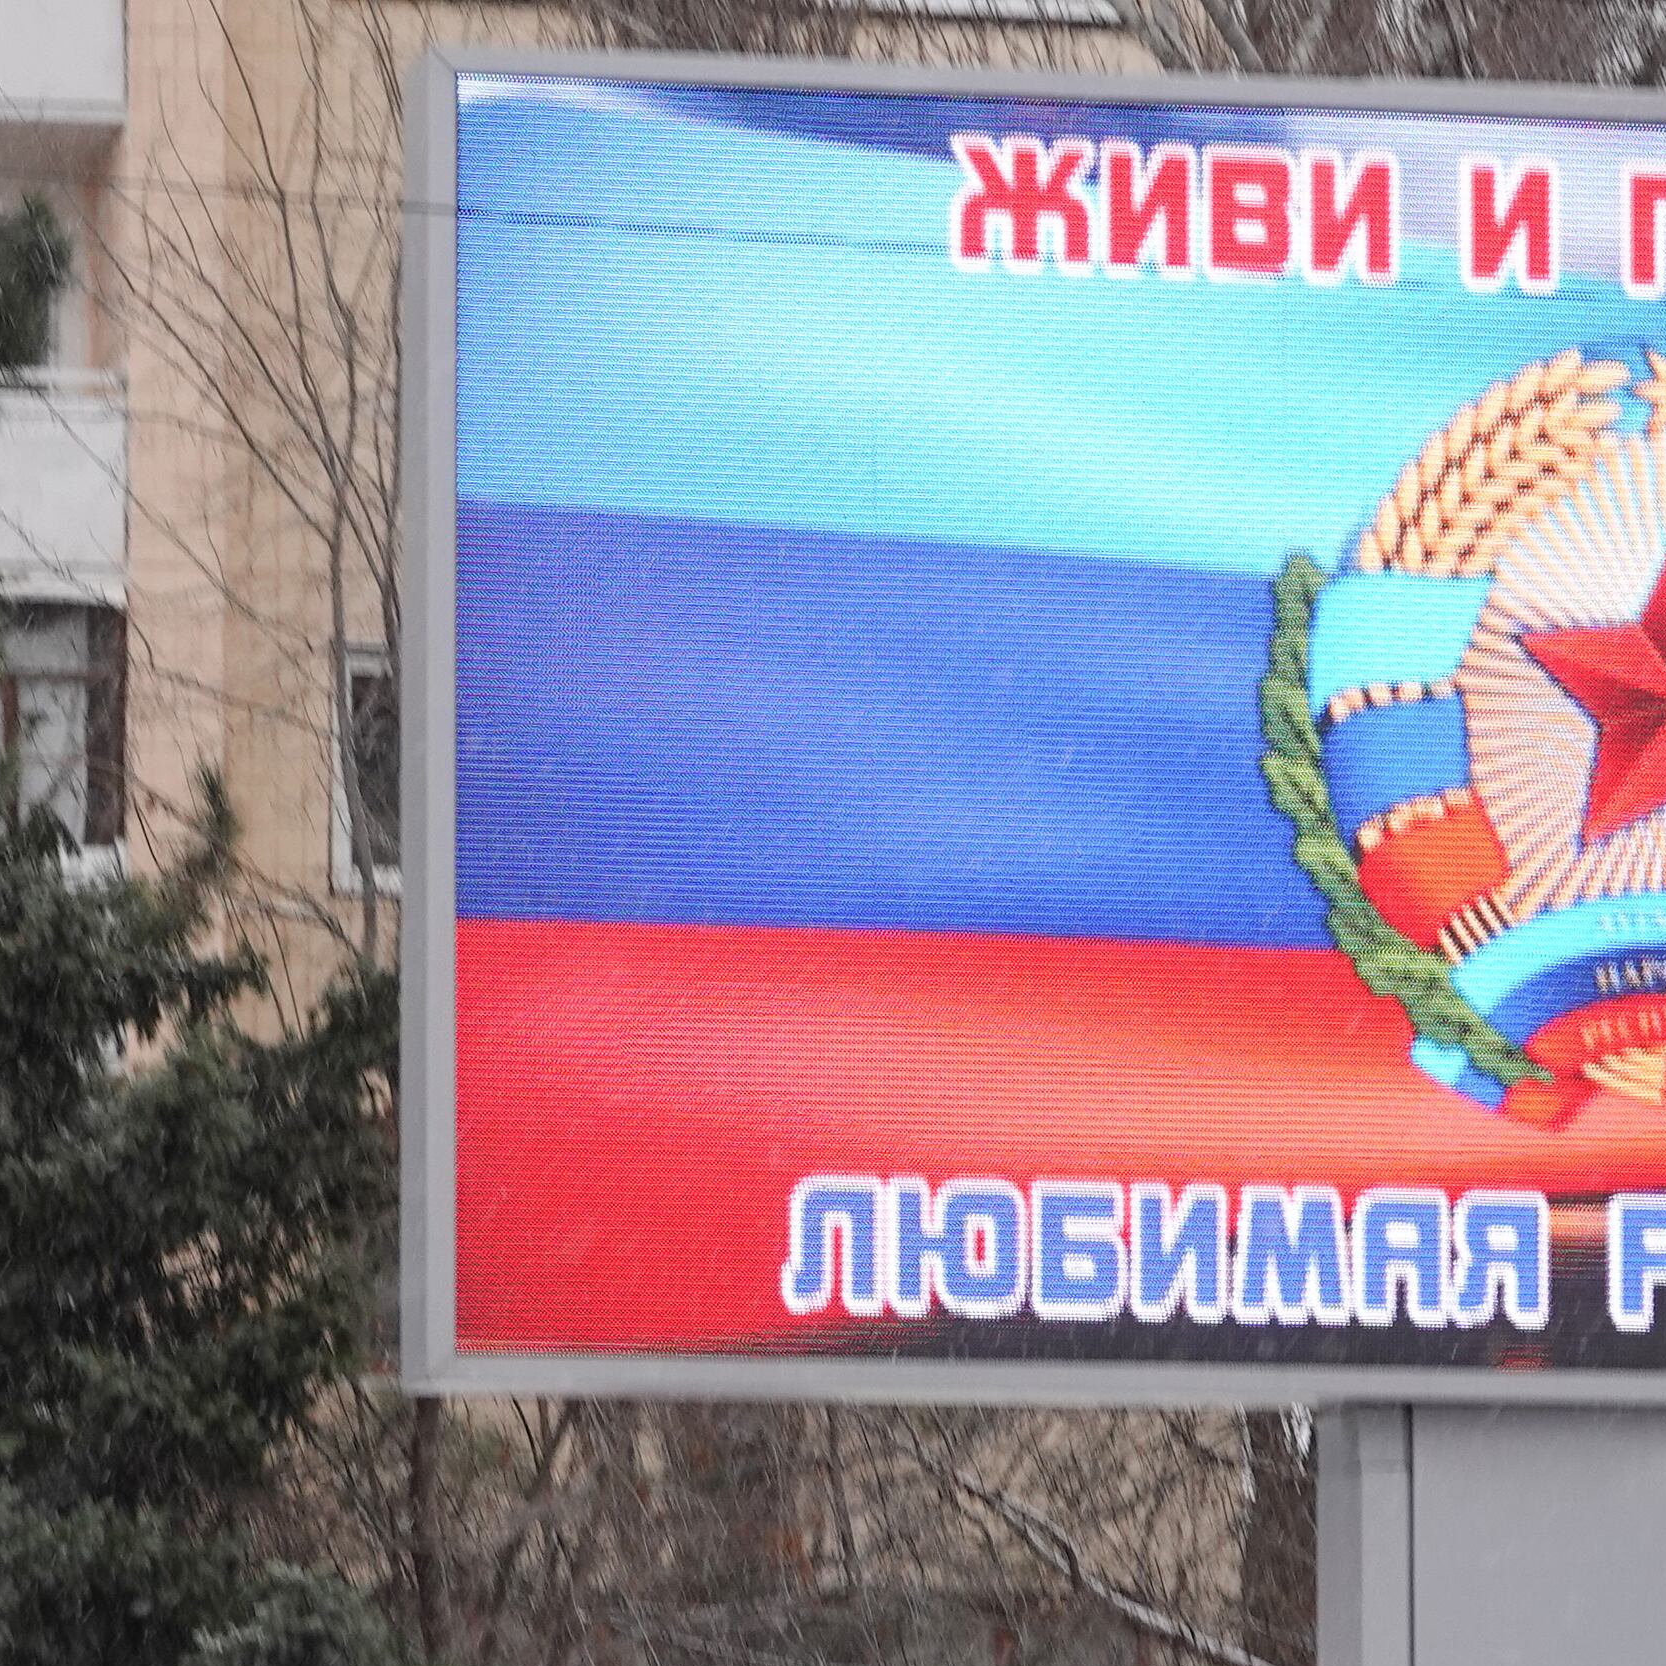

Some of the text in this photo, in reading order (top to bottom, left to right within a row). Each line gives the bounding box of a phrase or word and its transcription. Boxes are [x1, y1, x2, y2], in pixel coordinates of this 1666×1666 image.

[950, 132, 1401, 284] ЖИВИ
[1460, 154, 1559, 294] И
[781, 1173, 1550, 1331] ЛЮБИМАЯ
